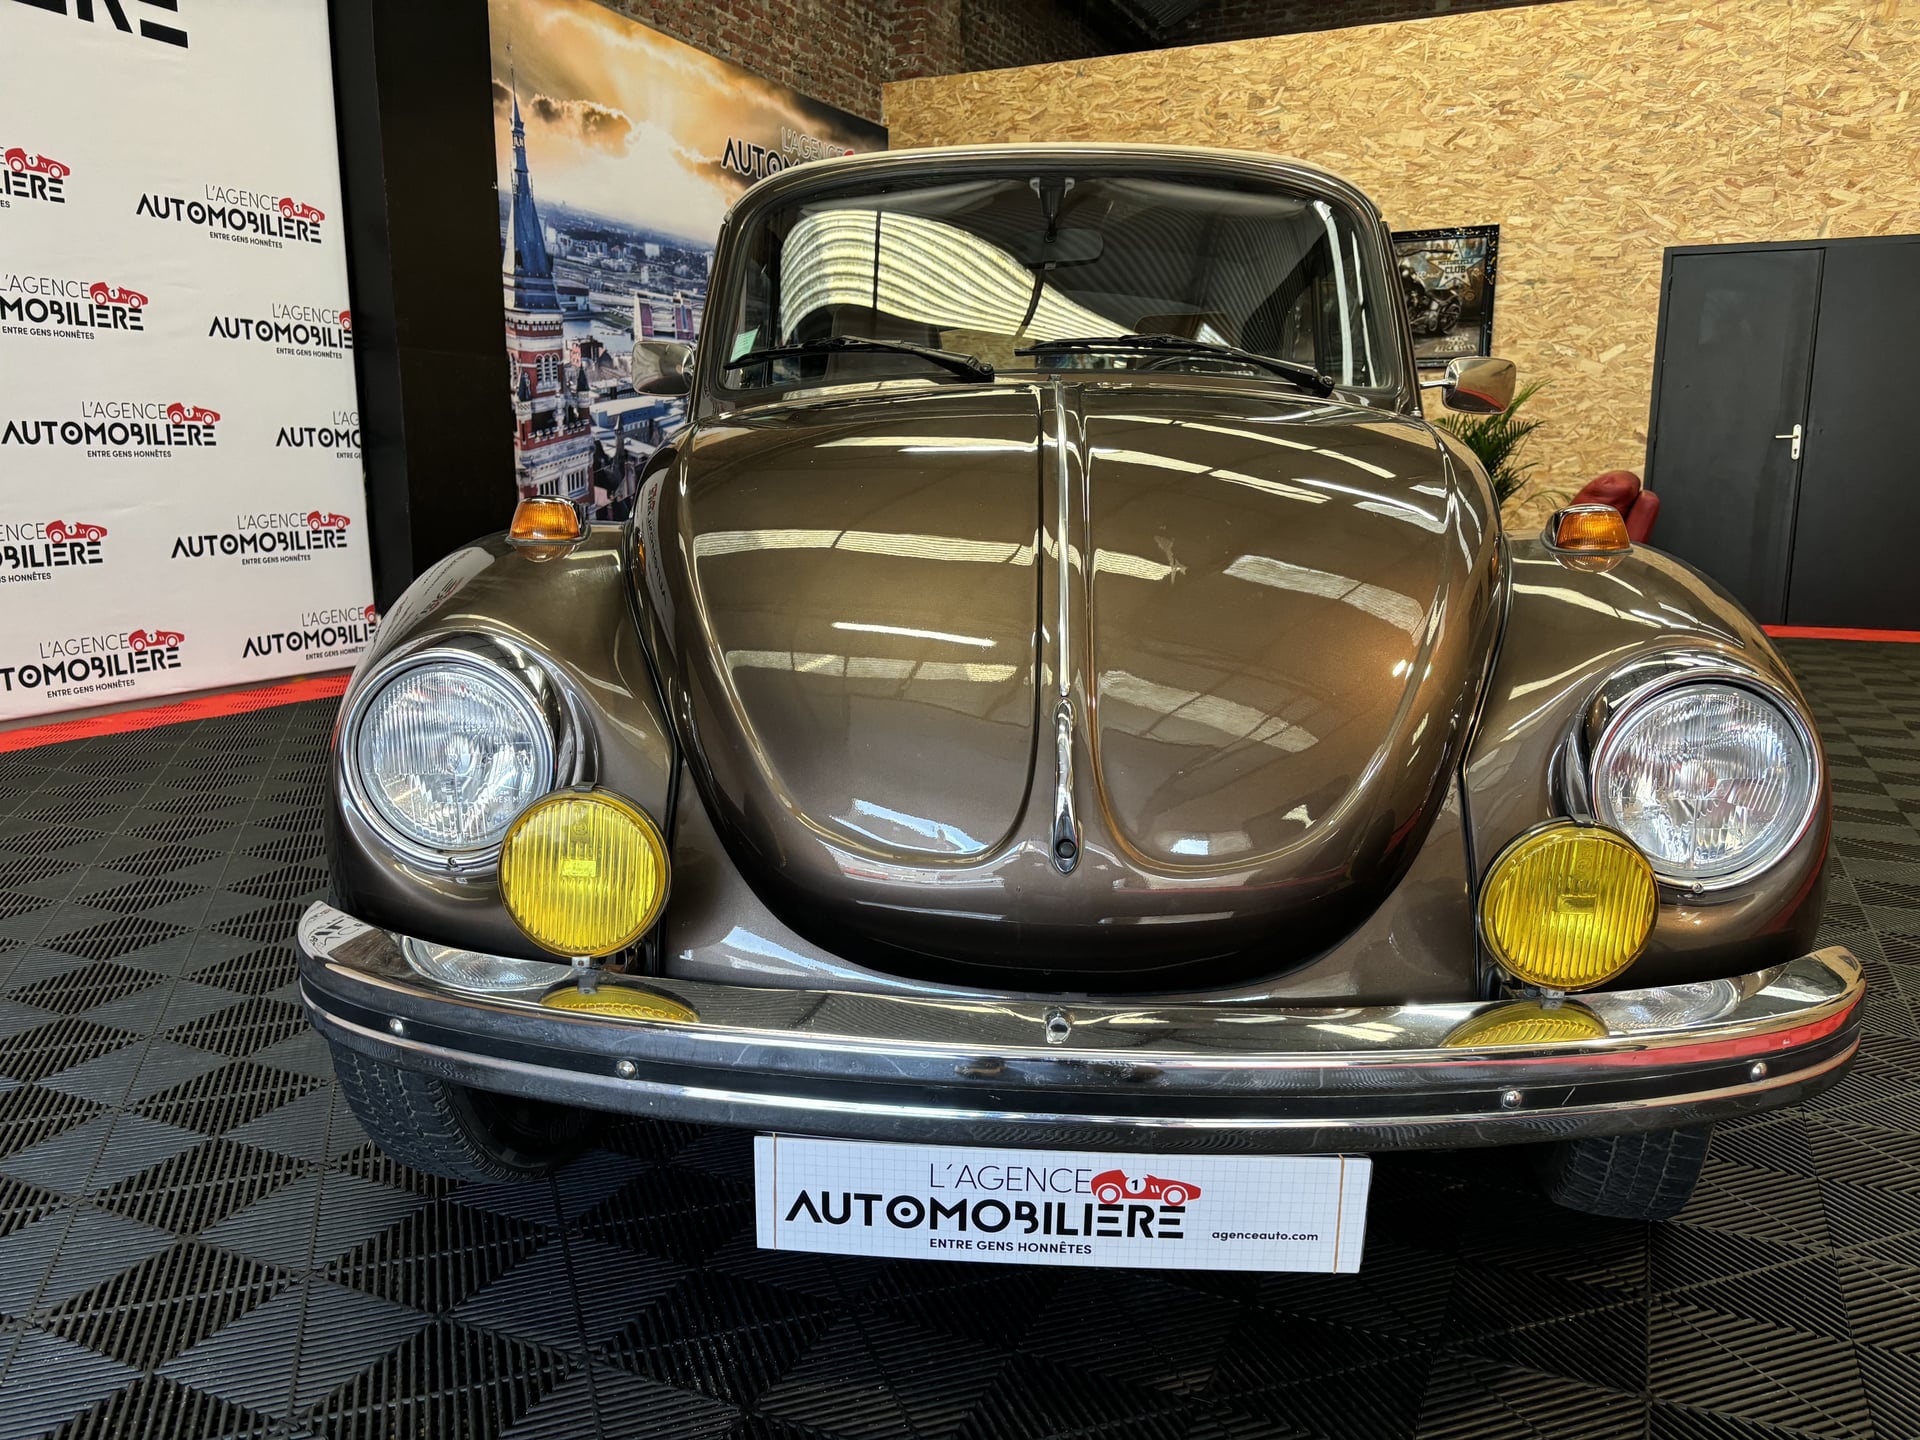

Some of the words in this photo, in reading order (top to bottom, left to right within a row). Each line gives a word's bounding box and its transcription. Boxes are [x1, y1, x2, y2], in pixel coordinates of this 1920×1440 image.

[205, 184, 280, 213] L'AGENCE
[209, 231, 230, 241] ENTRE
[231, 235, 249, 244] GENS
[250, 237, 283, 249] HONNÊTES
[1444, 265, 1467, 274] CLUB
[272, 303, 340, 325] L'AGENCE
[2, 326, 28, 335] ENTRE
[30, 328, 52, 337] GENS
[53, 329, 95, 340] HONNÊTES
[276, 347, 295, 355] ENTRE
[296, 349, 312, 357] GENS
[312, 350, 343, 359] HONNÊTES
[82, 401, 168, 420] L'AGENCE
[87, 450, 111, 458] ENTRE
[112, 450, 133, 458] GENS
[133, 449, 172, 458] HONNÊTES
[237, 512, 308, 530] L'AGENCE
[0, 541, 103, 570] BILIERE
[241, 557, 261, 566] ENTRE
[262, 556, 279, 564] GENS
[280, 553, 311, 563] HONNÊTES
[8, 571, 52, 583] HONNÊTES
[301, 606, 365, 627] L'AGENCE
[39, 632, 129, 659] L'AGENCE
[305, 652, 323, 661] ENTRE
[324, 650, 339, 658] GENS
[47, 688, 72, 699] ENTRE
[73, 684, 94, 695] GENS
[95, 679, 135, 692] HONNÊTES
[930, 1163, 1092, 1194] L'AGENCE
[785, 1189, 1186, 1239] AUTOMOBILIERE
[1211, 1230, 1319, 1242] agenceauto.com
[929, 1238, 973, 1250] ENTRE
[976, 1240, 1014, 1252] GENS
[1017, 1240, 1092, 1255] HONNÊTES
